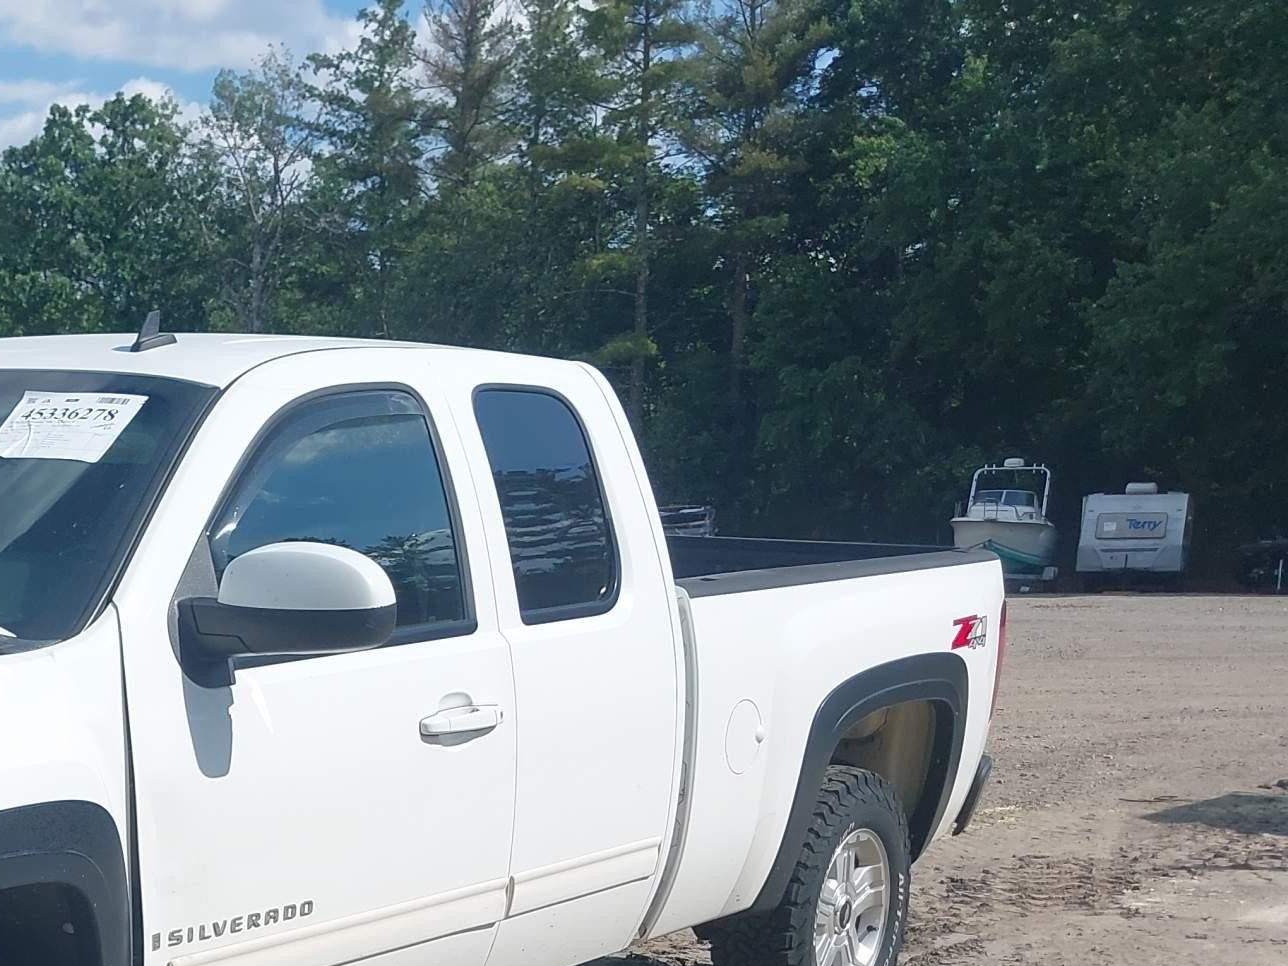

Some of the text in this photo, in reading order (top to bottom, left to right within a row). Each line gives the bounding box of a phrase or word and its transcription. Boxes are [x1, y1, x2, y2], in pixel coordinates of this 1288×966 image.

[21, 407, 119, 422] 45336278
[1126, 518, 1163, 531] Terry
[167, 900, 314, 947] SILVERADO
